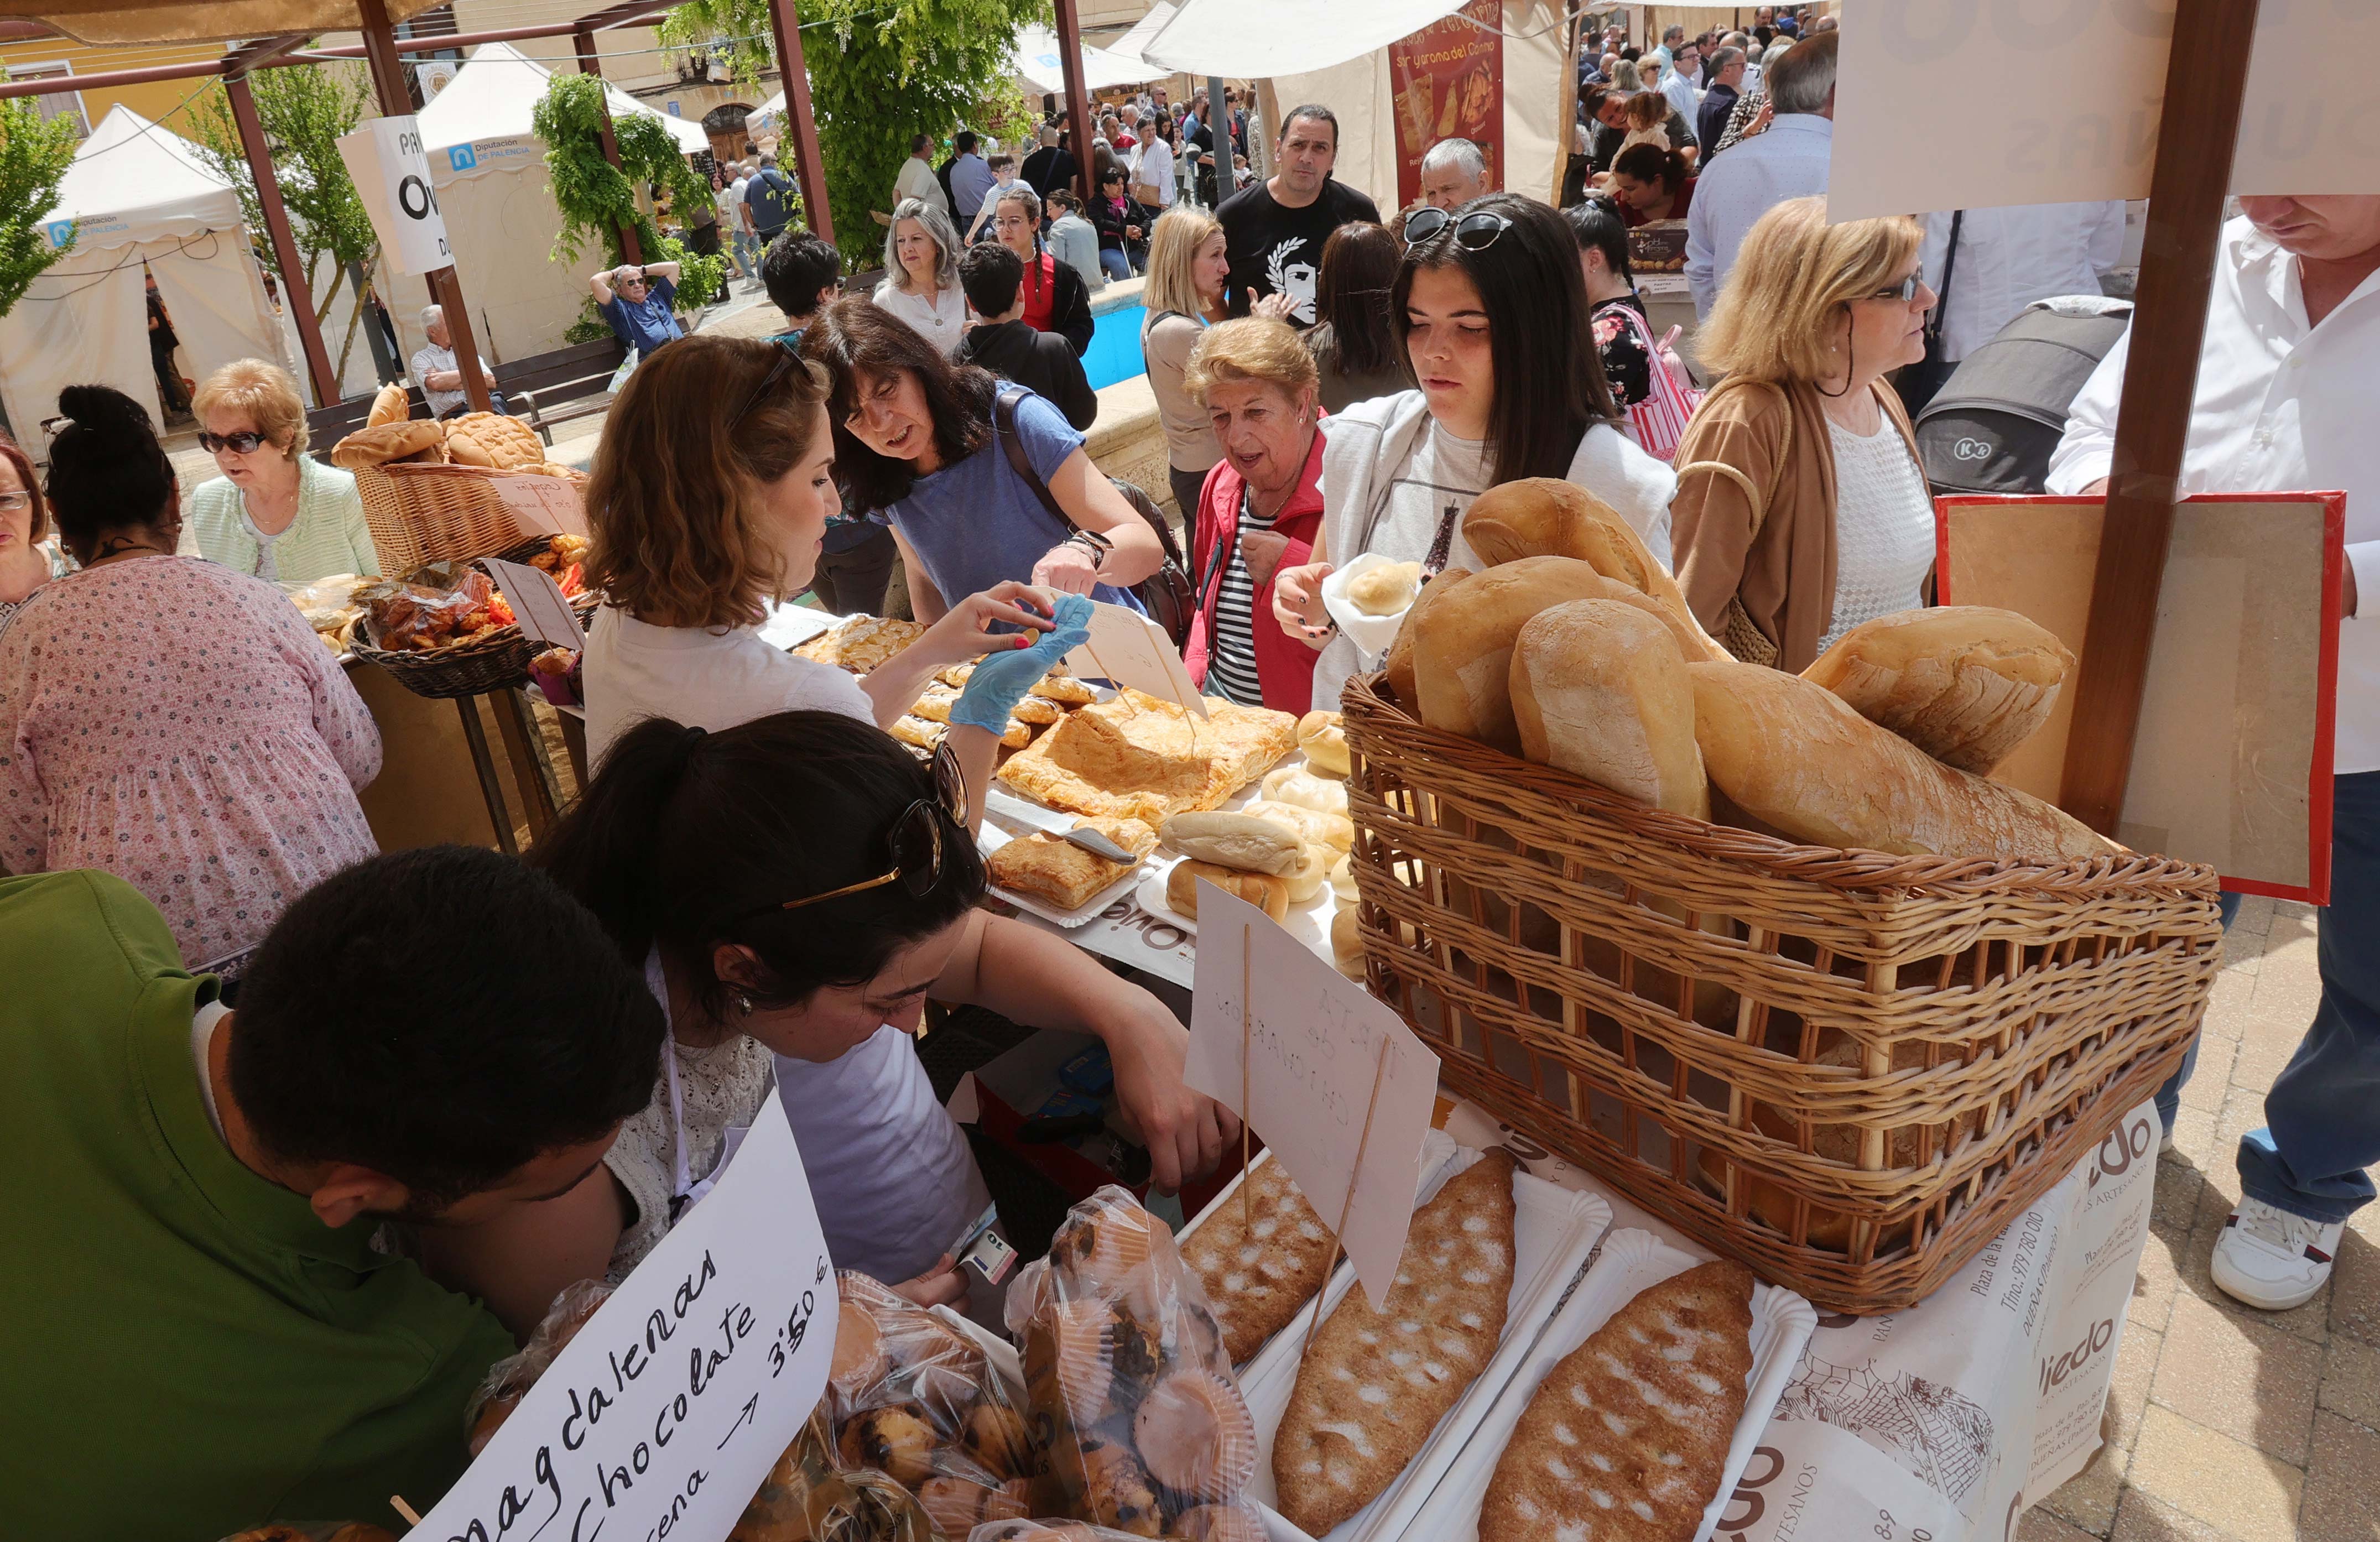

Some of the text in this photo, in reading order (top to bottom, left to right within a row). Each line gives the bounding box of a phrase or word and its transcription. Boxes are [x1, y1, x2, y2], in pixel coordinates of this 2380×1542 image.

[475, 139, 518, 152] Diputación
[478, 147, 530, 161] DE PALENCIA
[79, 216, 117, 227] iputación
[91, 223, 129, 235] PALENCIA
[1981, 1252, 1998, 1267] de
[2001, 1211, 2044, 1312] Tfno.: 979 780 010
[1970, 1269, 1994, 1297] Plaza
[2023, 1277, 2044, 1337] DUEÑAS
[2055, 1417, 2066, 1428] de
[2030, 1439, 2066, 1471] DUEÑAS
[1874, 1508, 1897, 1541] 8-9
